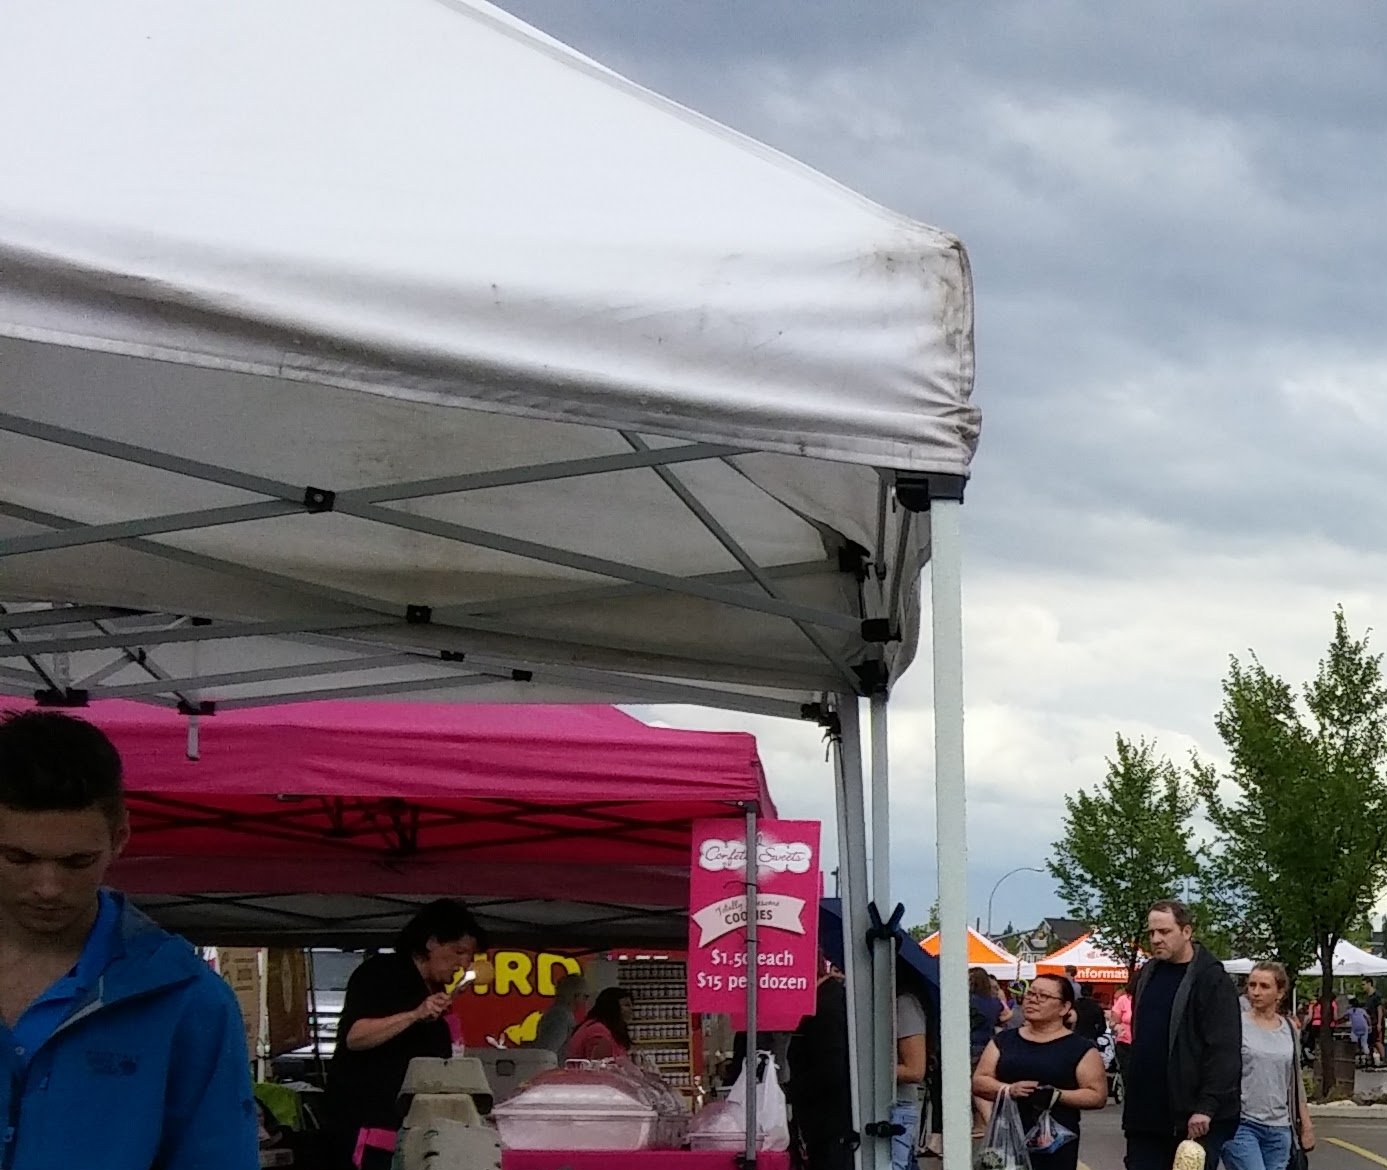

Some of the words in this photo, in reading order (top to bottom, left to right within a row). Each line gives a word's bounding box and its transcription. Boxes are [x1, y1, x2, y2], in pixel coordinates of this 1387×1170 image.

[724, 910, 773, 925] COOIES
[757, 950, 793, 966] each
[444, 951, 581, 996] IRD
[697, 972, 722, 990] $15
[728, 976, 748, 992] pe
[759, 973, 807, 990] dozen
